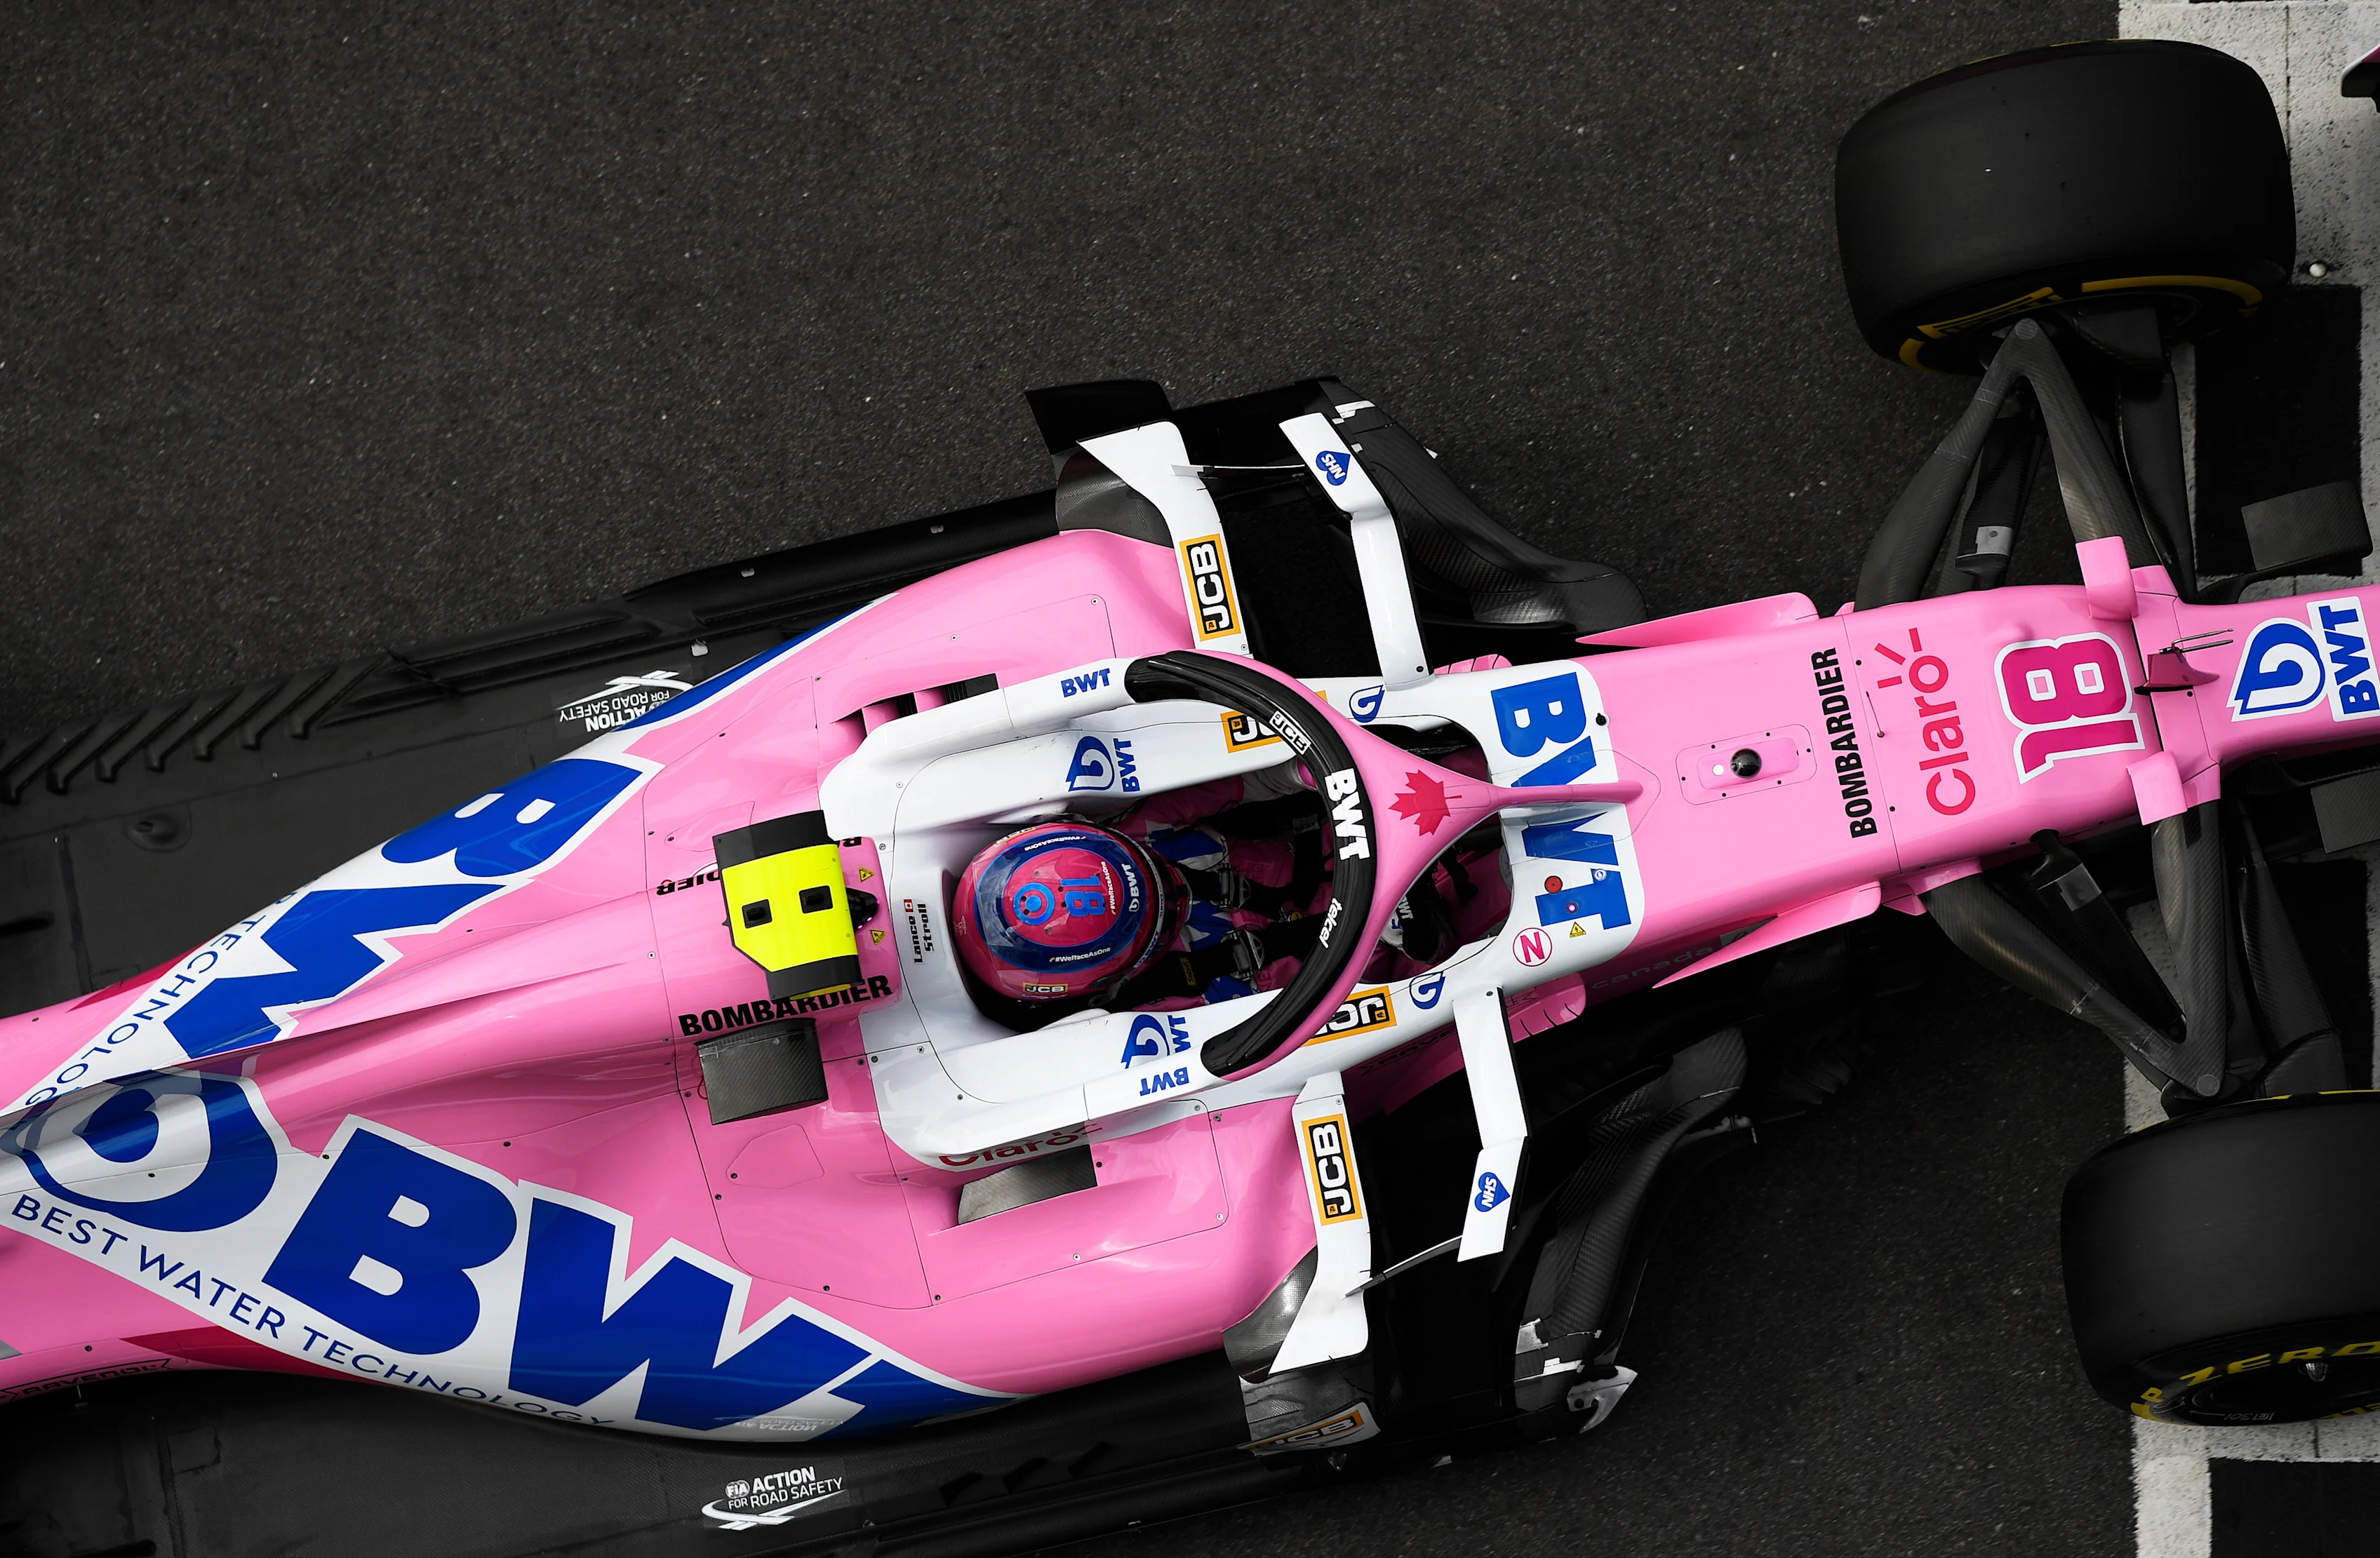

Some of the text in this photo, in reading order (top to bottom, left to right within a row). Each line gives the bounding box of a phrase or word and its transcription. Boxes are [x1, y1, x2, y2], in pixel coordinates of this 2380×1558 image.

[1321, 453, 1346, 480] NHS
[1190, 544, 1230, 629] JCB
[1061, 668, 1110, 698] BWT
[2319, 605, 2379, 714] BWT
[559, 702, 610, 723] SAFETY
[612, 692, 649, 711] ROAD
[1995, 634, 2144, 782] 18
[1272, 713, 1307, 751] JCB
[1811, 647, 1878, 838] BOMBARDIER
[1918, 655, 1976, 816] Claro
[1113, 738, 1140, 793] BWT
[1325, 768, 1370, 861] BWT
[1491, 672, 1631, 929] BWT
[1060, 875, 1107, 918] 18
[1121, 864, 1139, 897] BWT
[909, 915, 923, 963] Lance
[917, 904, 935, 952] Stroll
[1319, 897, 1343, 948] telcel
[1055, 947, 1111, 962] #WeRaceAsOne
[25, 915, 267, 1106] TECHNOLOG
[678, 975, 893, 1036] BOMBARDIER
[1167, 1014, 1191, 1054] WT
[1139, 1067, 1189, 1096] BWT
[1313, 1124, 1352, 1214] JCB
[1481, 1176, 1497, 1208] NHS
[11, 1194, 616, 1425] BEST WATER TECHNOLOGY
[2141, 1341, 2380, 1403] P ZERO
[728, 1476, 843, 1510] FOR ROAD SAFETY
[752, 1465, 816, 1494] ACTION
